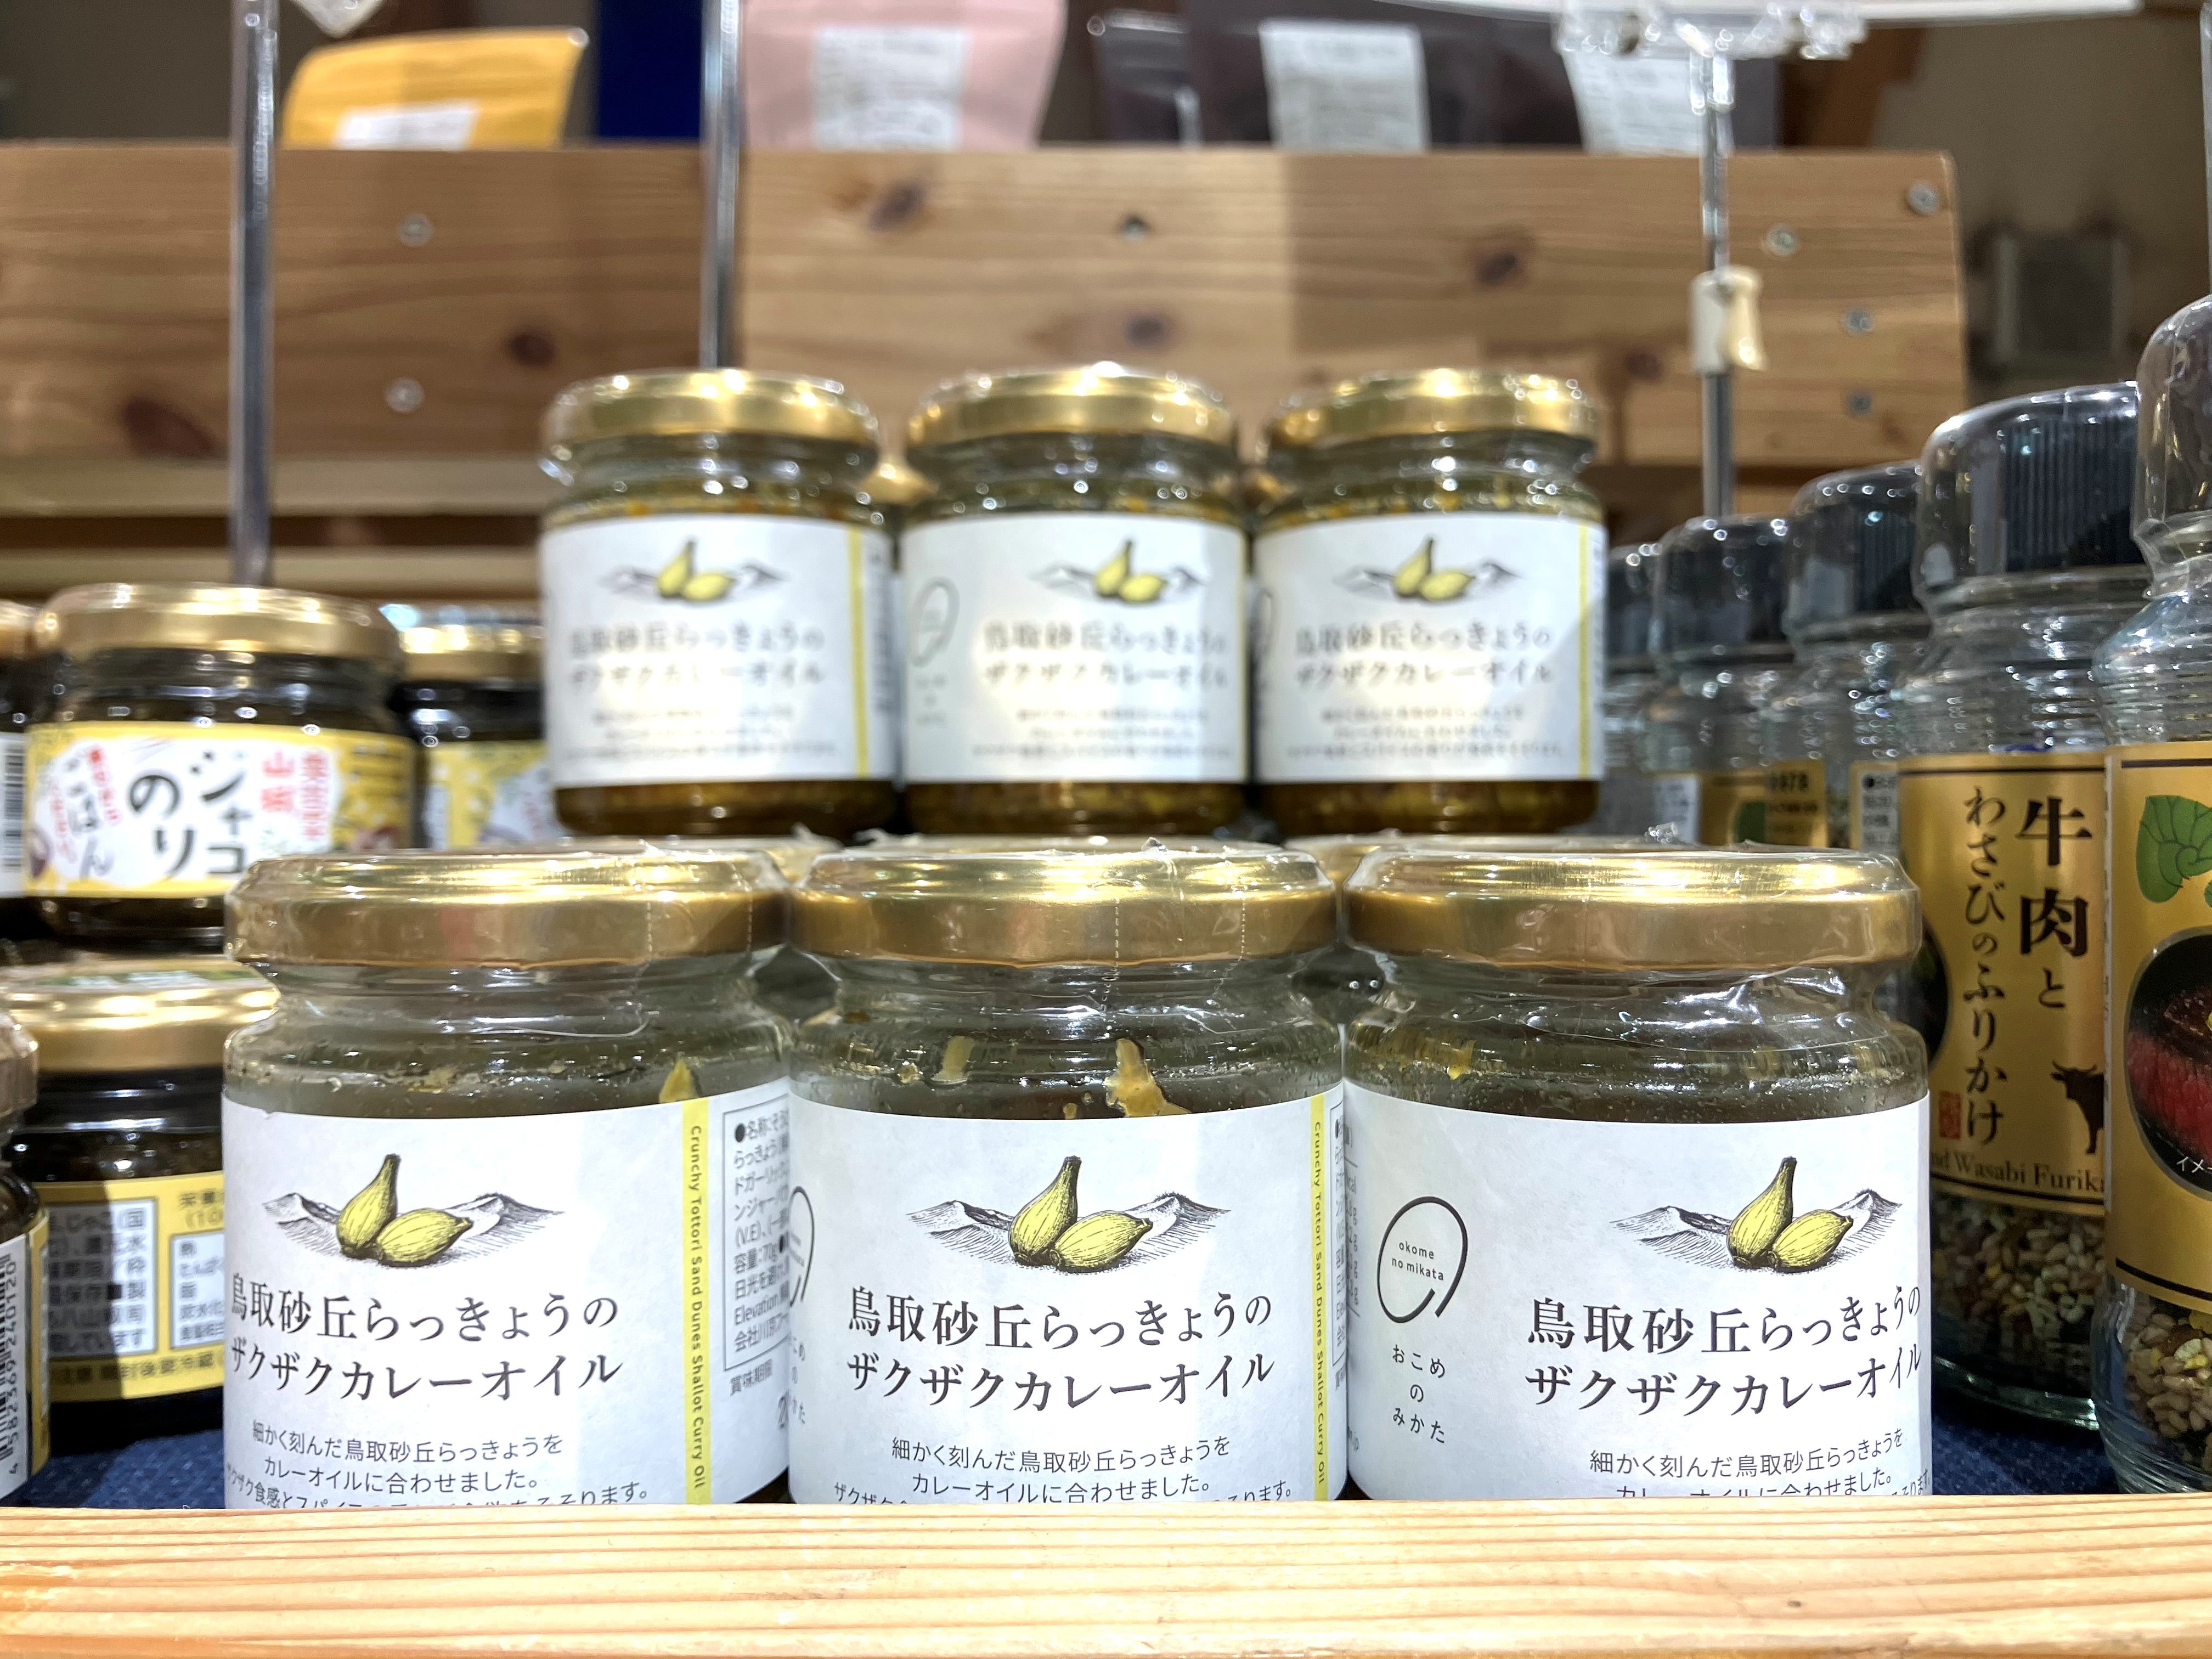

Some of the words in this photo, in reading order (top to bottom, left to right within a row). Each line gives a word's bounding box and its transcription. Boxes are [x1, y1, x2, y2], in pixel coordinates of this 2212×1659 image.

[2015, 797, 2092, 1008] 牛肉と
[1962, 786, 2006, 1145] わさびのふりかけ
[689, 1125, 702, 1192] Crunchy
[1953, 1152, 2026, 1184] Wasabi
[691, 1197, 702, 1251] Tottori
[1391, 1256, 1404, 1269] no
[1406, 1262, 1444, 1281] mikata
[1398, 1240, 1435, 1260] okome
[691, 1256, 703, 1296] Sand
[232, 1273, 618, 1342] 鳥取砂丘らっきょうの
[692, 1301, 703, 1351] Dunes
[849, 1285, 1272, 1349] 鳥取砂丘らっきょうの
[1528, 1285, 1920, 1355] 鳥取砂丘らっきょうの
[232, 1336, 623, 1402] ザクザクカレーオイル
[847, 1351, 1275, 1412] ザクザクカレーオイル
[1392, 1344, 1446, 1378] おこめ
[1525, 1344, 1922, 1417] ザクザクカレーオイル
[692, 1355, 704, 1414] Shallot
[1410, 1384, 1424, 1402] の
[253, 1420, 563, 1463] 細かく刻んだ鳥取砂丘らっきょうを
[692, 1417, 704, 1460] Curry
[1392, 1407, 1445, 1444] みかた
[264, 1455, 538, 1495] カレーオイルに合わせました。
[891, 1435, 1230, 1474] 細かく刻んだ鳥取砂丘らっきょうを
[1590, 1428, 1903, 1478] 細かく刻んだ鳥取砂丘らっきょうを
[694, 1465, 706, 1489] Oil
[912, 1473, 1209, 1504] カレーオイルに合わせました。
